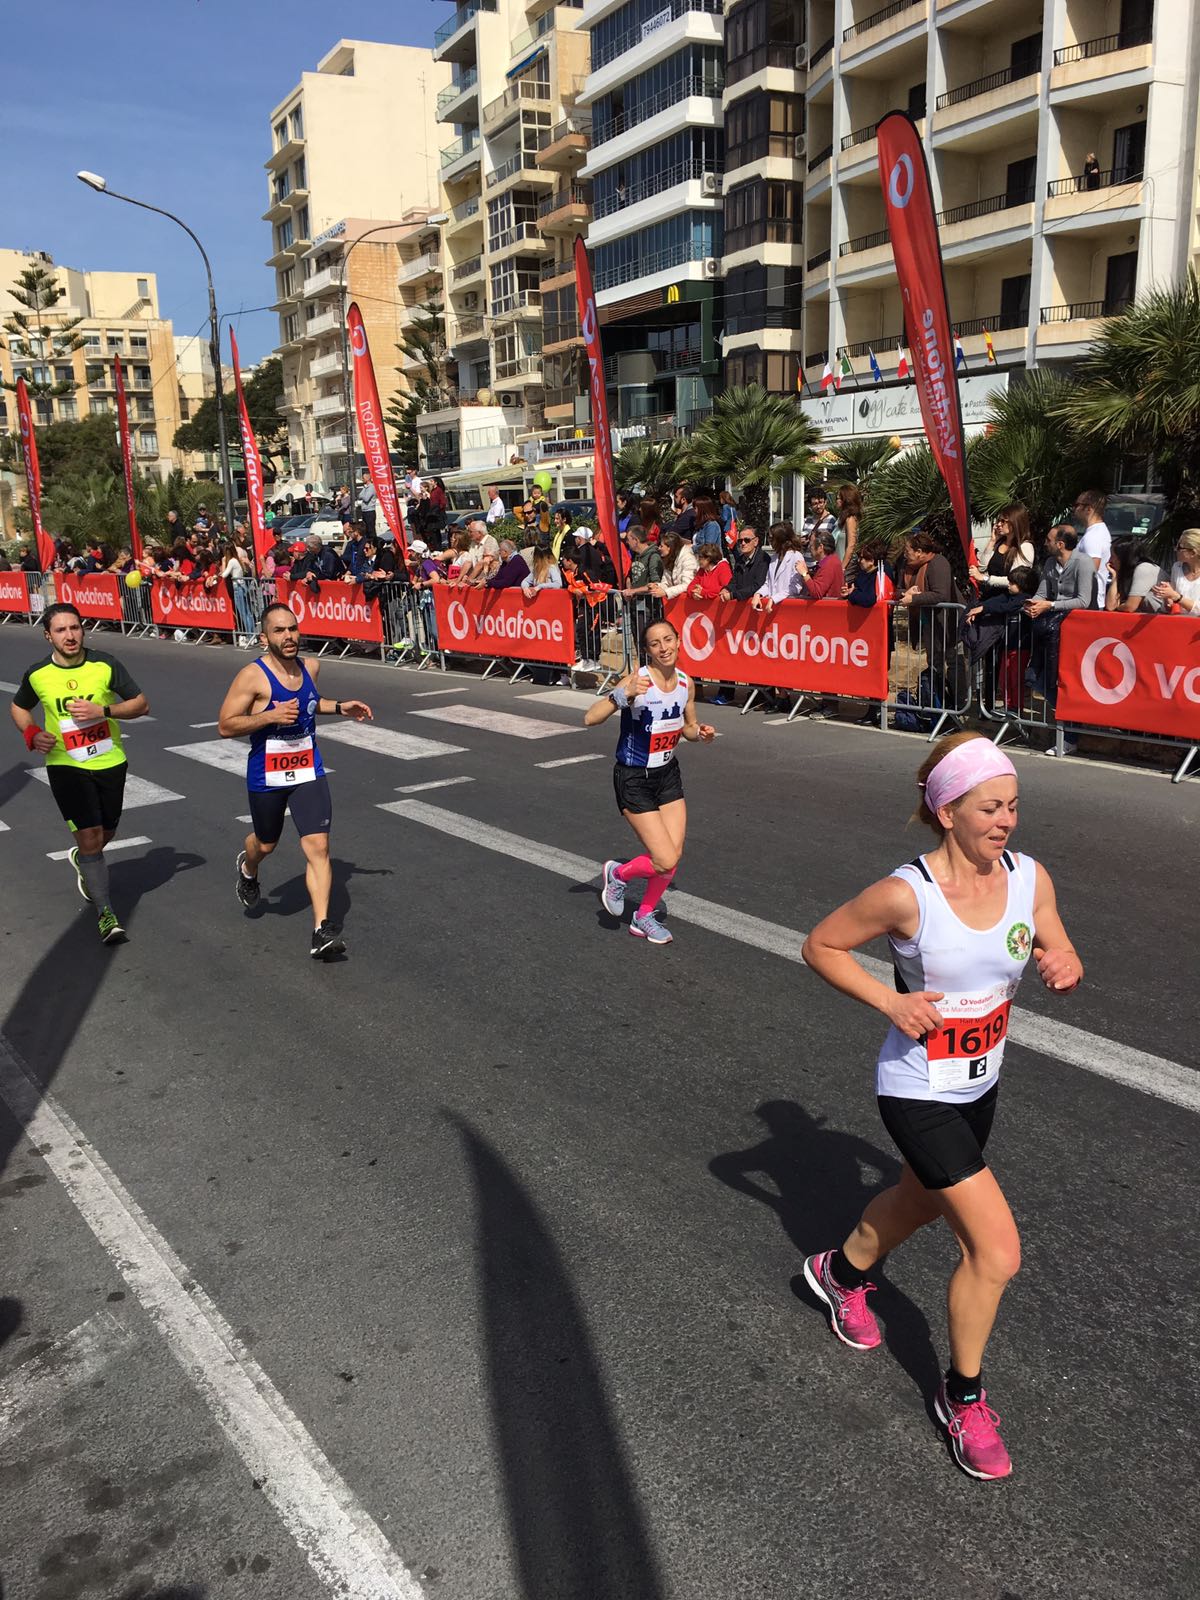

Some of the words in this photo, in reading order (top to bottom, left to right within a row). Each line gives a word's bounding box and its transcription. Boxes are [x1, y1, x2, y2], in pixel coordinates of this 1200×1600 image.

[825, 416, 848, 424] MARINA
[74, 587, 114, 606] vodafone
[175, 591, 227, 613] vodafone
[308, 596, 372, 623] vodafone
[472, 608, 563, 642] vodafone
[725, 623, 869, 668] vodafone
[69, 726, 106, 747] 1766
[271, 753, 309, 770] 1096
[951, 1005, 983, 1013] Marathon
[943, 1014, 1004, 1055] 1619
